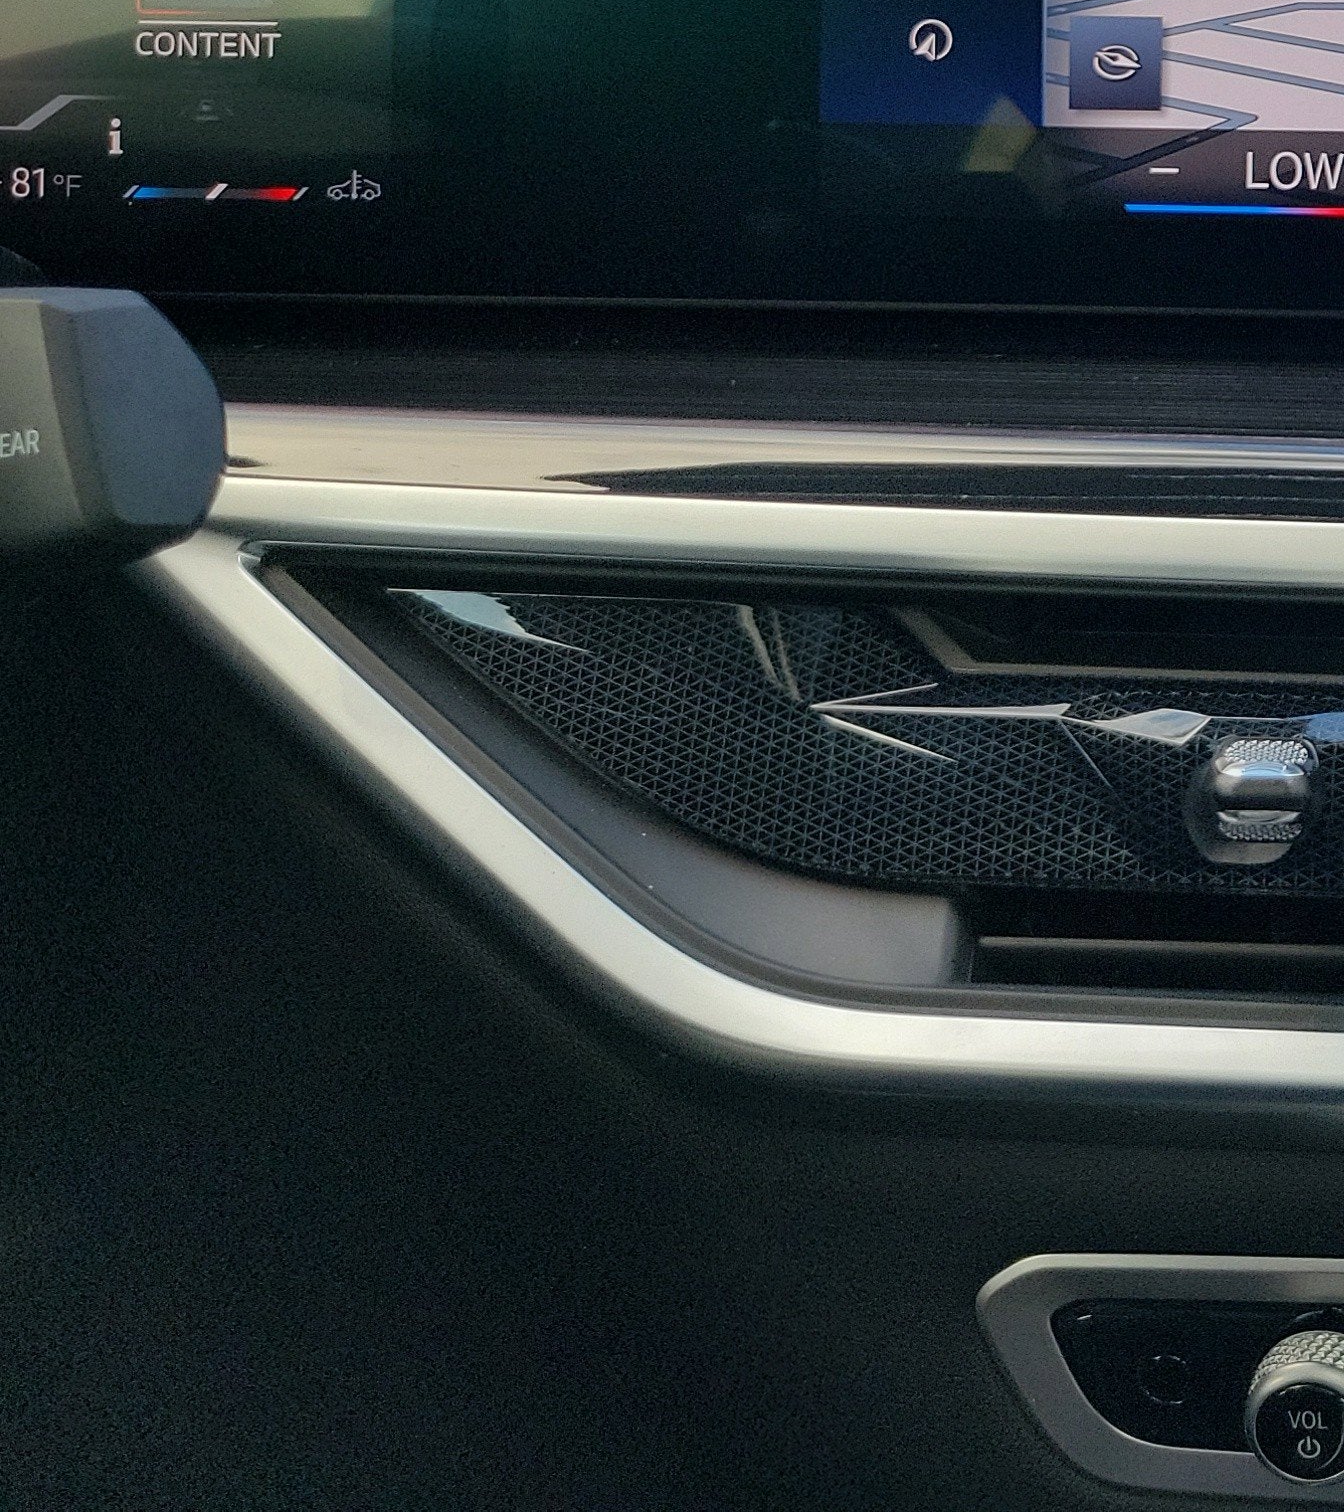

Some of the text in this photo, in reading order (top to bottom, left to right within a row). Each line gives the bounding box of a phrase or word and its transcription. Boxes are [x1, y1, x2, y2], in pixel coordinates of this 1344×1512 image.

[135, 31, 282, 59] CONTENT
[11, 166, 46, 199] 81
[1245, 151, 1344, 191] LOW
[1287, 1410, 1328, 1429] VOL
